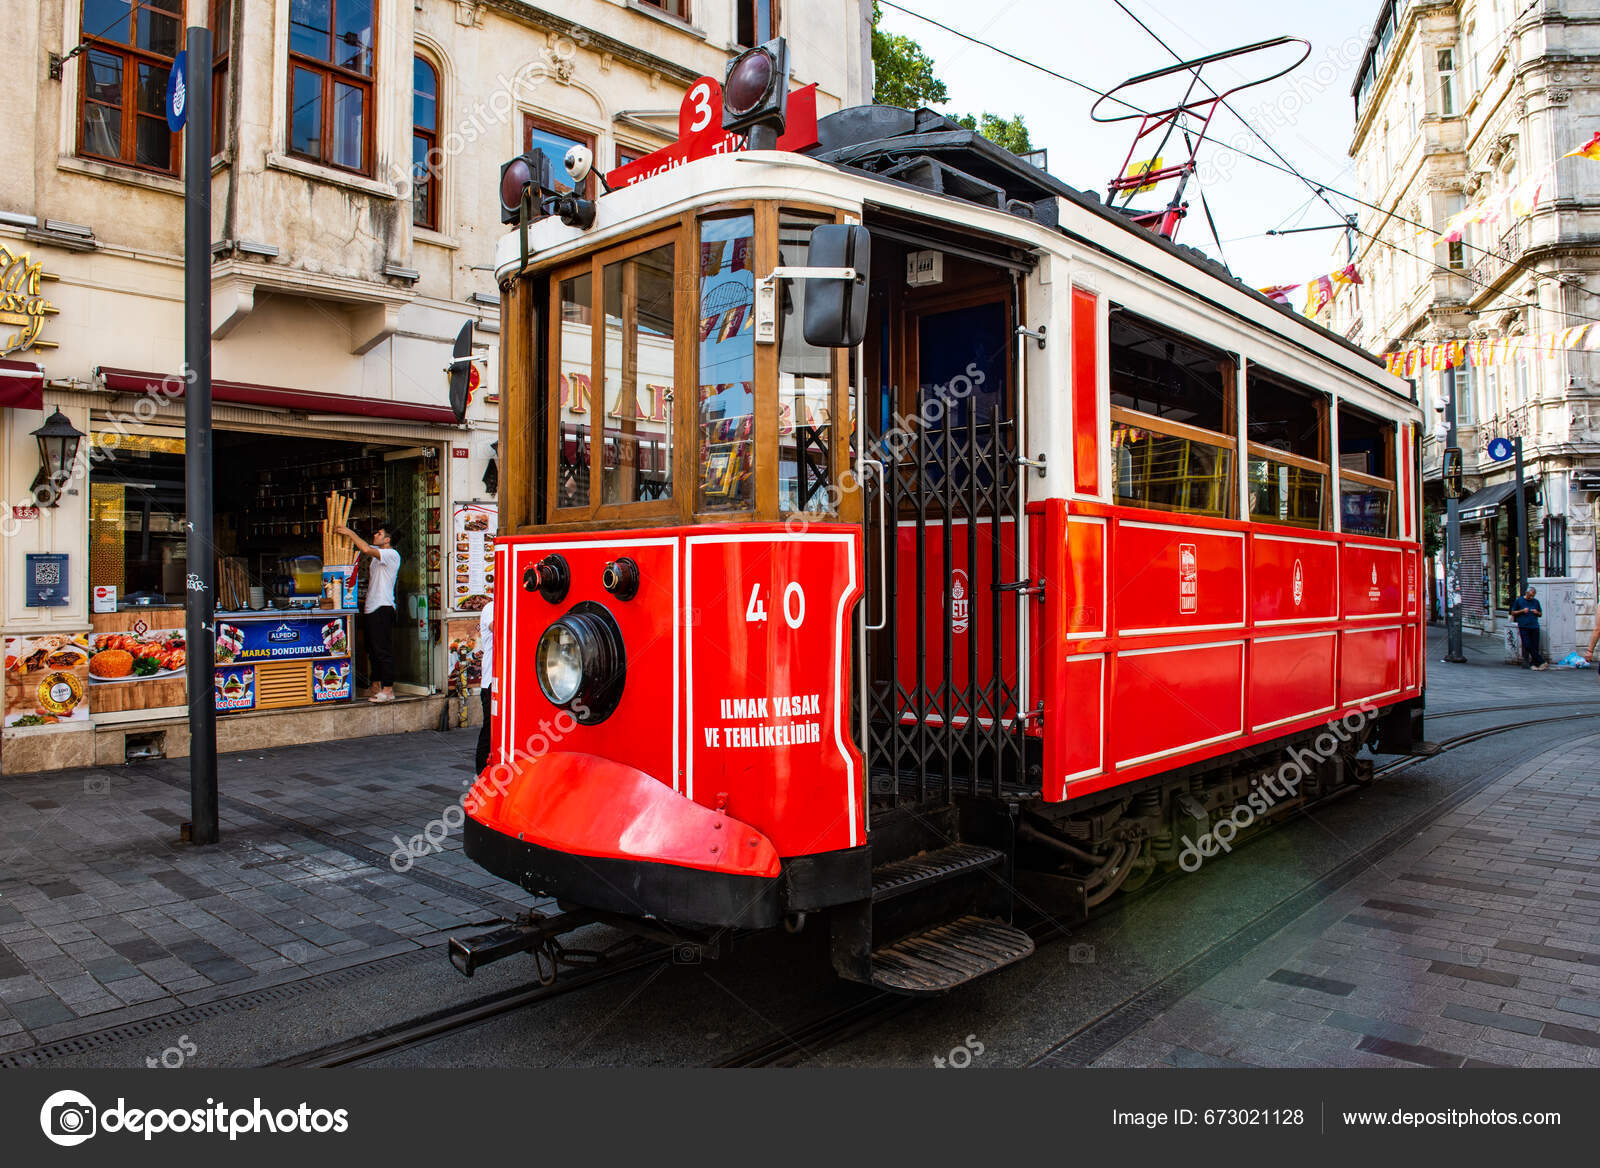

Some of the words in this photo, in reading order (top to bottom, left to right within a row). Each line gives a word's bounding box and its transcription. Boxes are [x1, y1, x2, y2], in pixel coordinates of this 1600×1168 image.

[689, 83, 712, 132] 3
[0, 292, 44, 316] ssa
[1312, 290, 1328, 307] 23
[271, 631, 298, 639] ALPEDO
[241, 648, 271, 659] MARAŞ
[272, 645, 325, 656] DONDURMASI
[326, 689, 348, 698] Cream
[228, 698, 251, 707] Cream
[720, 698, 768, 719] ILMAK
[773, 694, 820, 717] YASAK
[704, 728, 720, 748] VE
[724, 719, 820, 748] TEHLİKELİDİR
